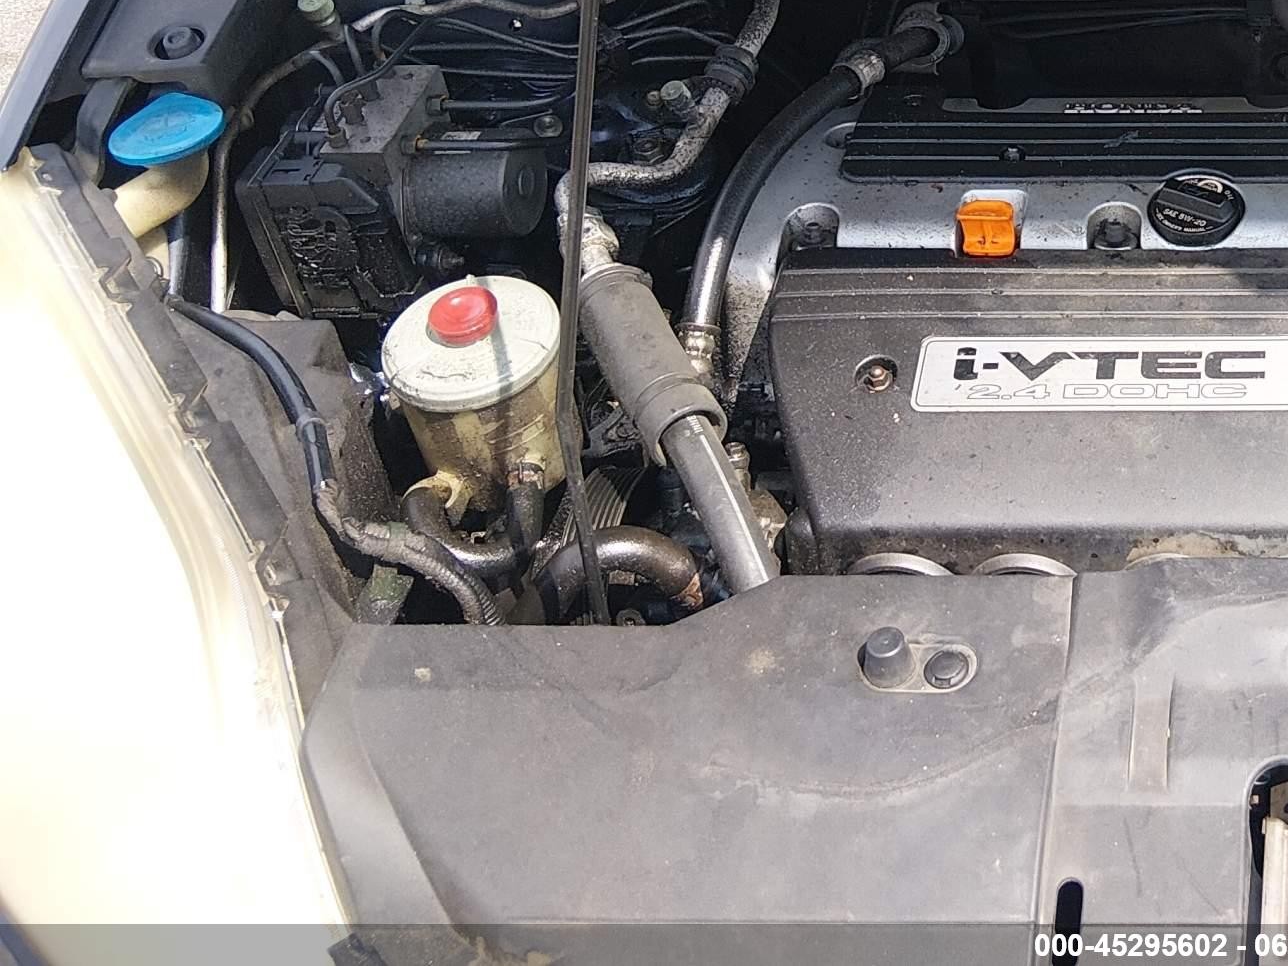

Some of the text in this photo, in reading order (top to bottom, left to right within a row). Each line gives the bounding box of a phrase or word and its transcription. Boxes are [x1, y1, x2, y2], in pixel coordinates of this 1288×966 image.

[1063, 102, 1203, 114] HONDA
[953, 346, 1266, 381] i-VTEC
[966, 383, 1248, 401] 2.4 DOHC
